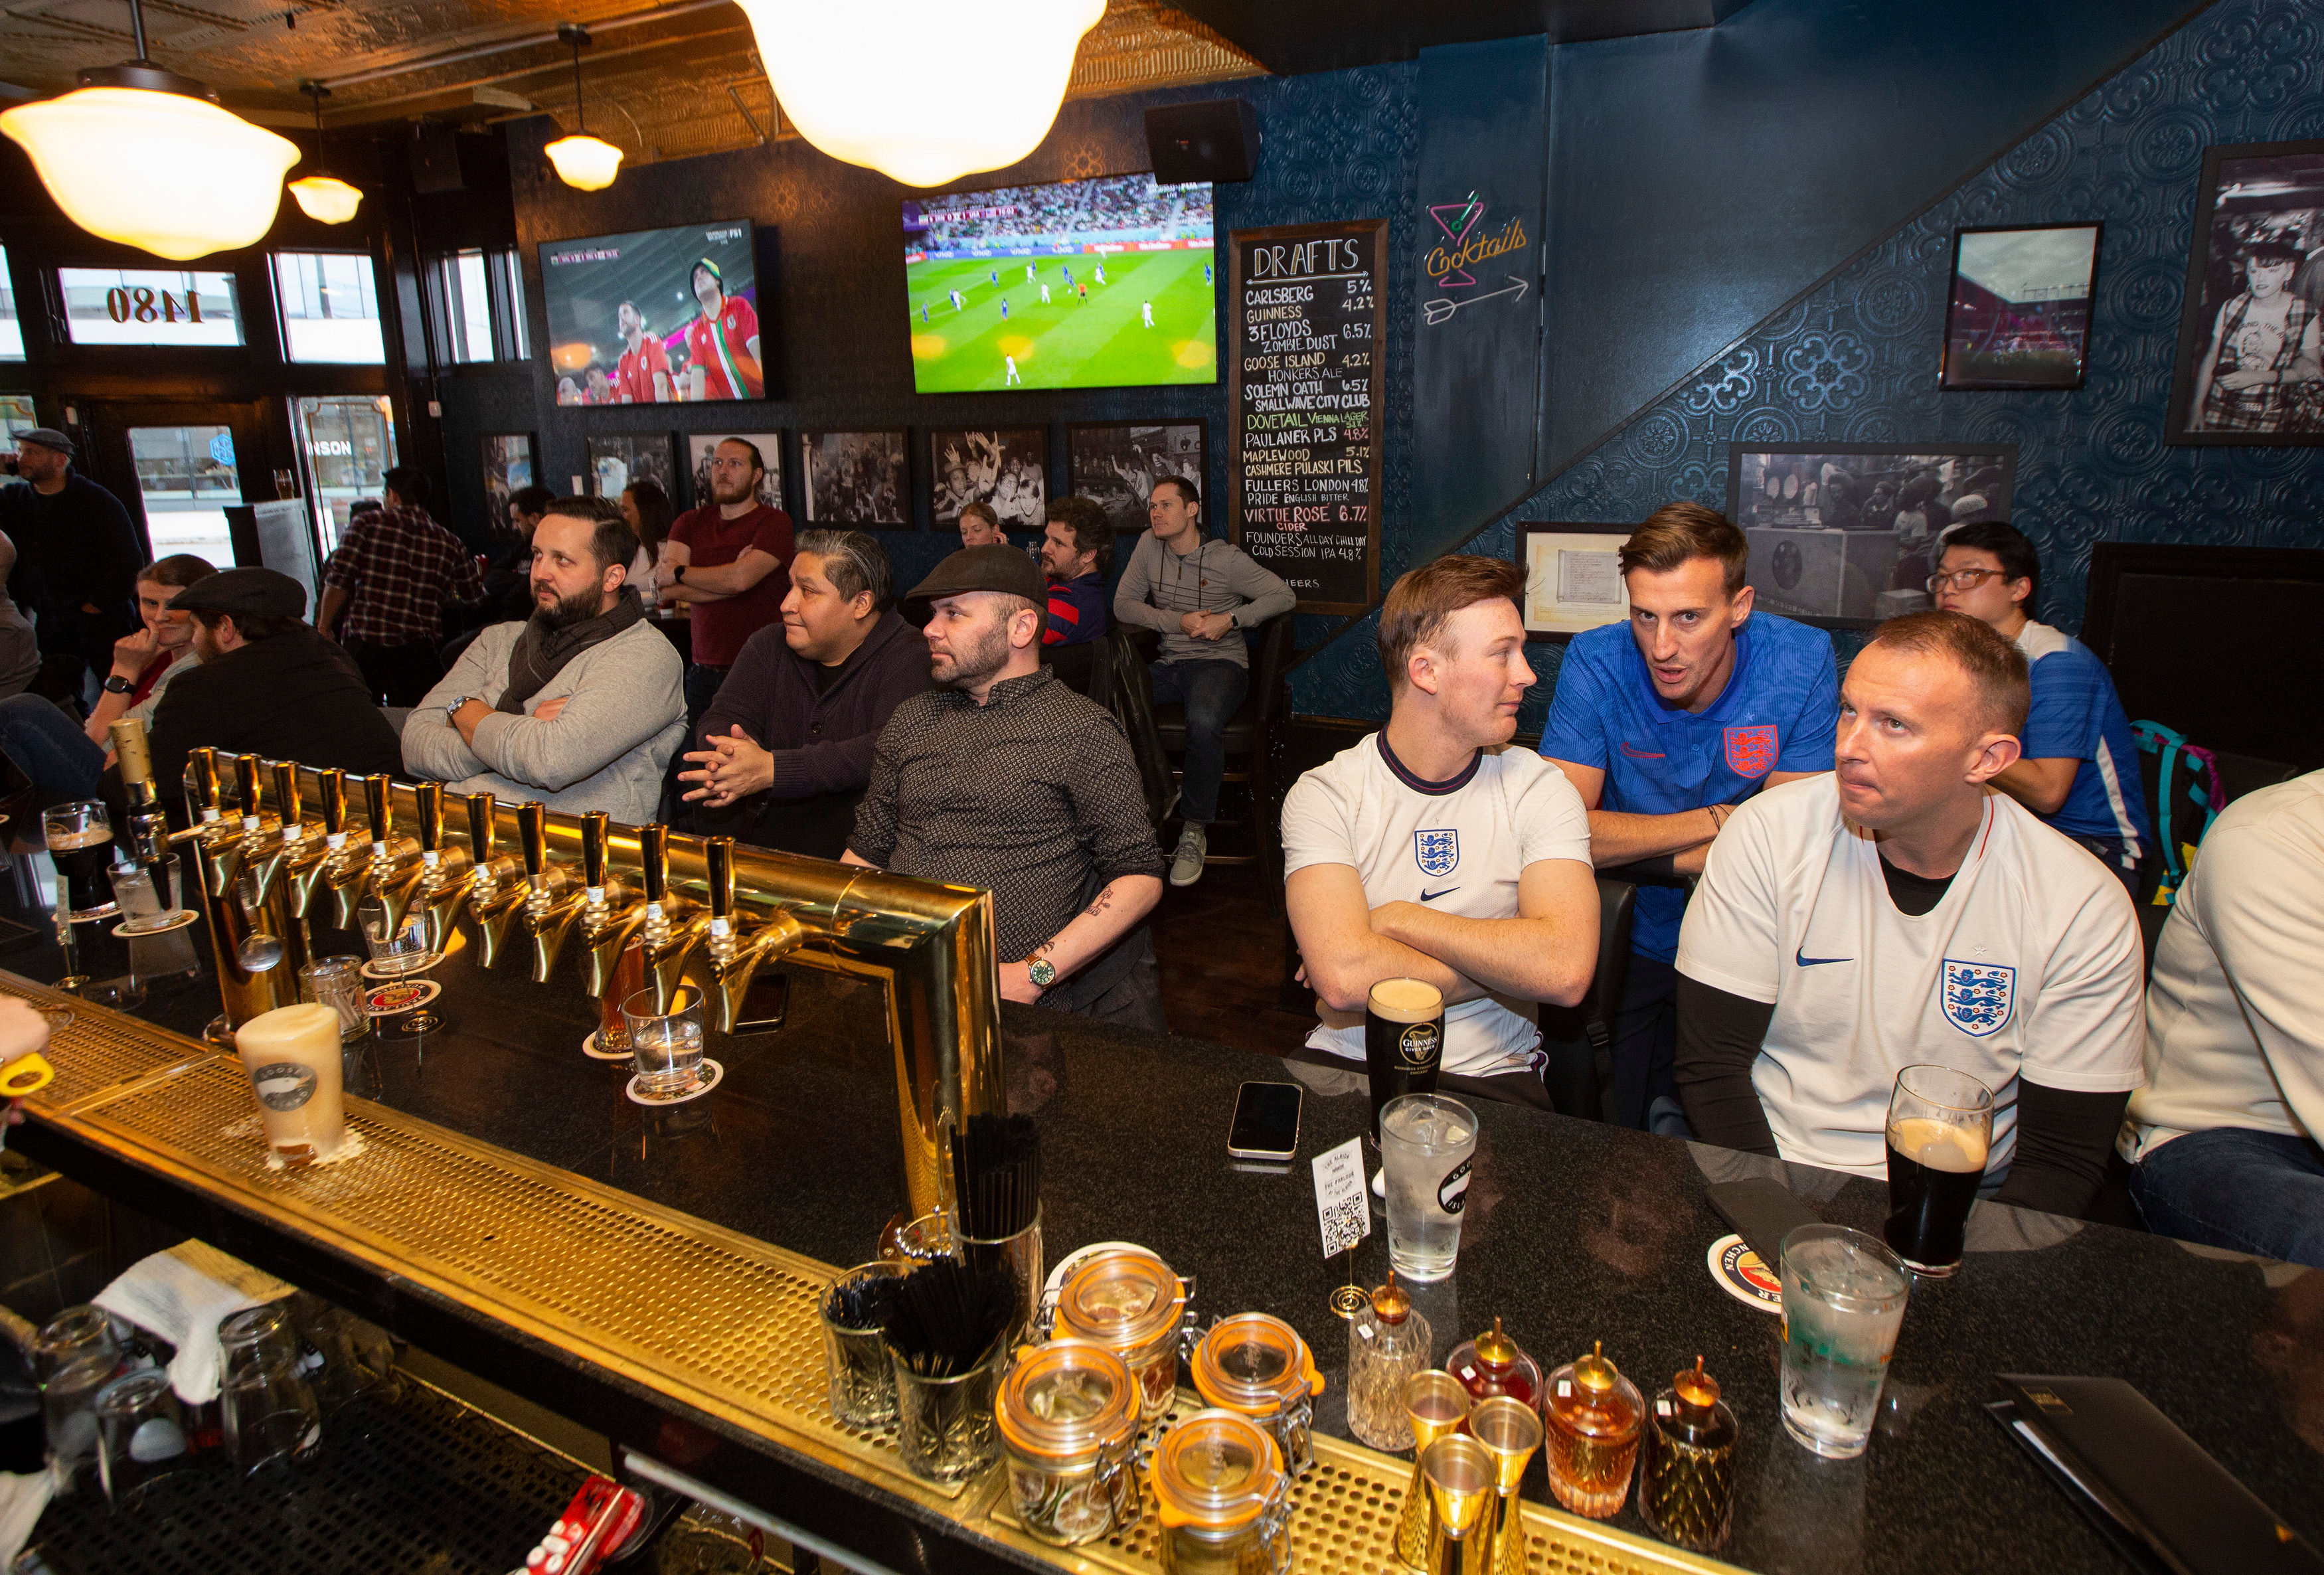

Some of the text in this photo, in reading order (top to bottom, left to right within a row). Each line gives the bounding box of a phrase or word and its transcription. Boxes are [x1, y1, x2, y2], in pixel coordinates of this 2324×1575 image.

[1254, 238, 1359, 276] DRAFTS
[1428, 219, 1527, 277] Cocktails
[1246, 279, 1372, 305] CARLSBERG 5%
[1246, 296, 1374, 323] GUINNESS 4.2%
[1248, 319, 1371, 341] 3 FLOYDS 6.5%
[1262, 334, 1338, 353] ZOMBIE DUST
[1244, 352, 1370, 371] GOOSE ISLAND 4.2%
[1268, 367, 1343, 382] HONKERS ALE
[1244, 378, 1368, 400] SOLEMN OATH 6.5%
[1317, 394, 1340, 408] CITY
[1341, 394, 1370, 408] CLUB
[1247, 413, 1308, 430] DOVETAIL
[1340, 410, 1369, 423] LAGER
[1246, 426, 1369, 448] PAULANER PLS 4.8%
[1243, 446, 1370, 463] MAPLEWOOD 5.1%
[1245, 459, 1363, 477] CASHMERE PULASKI PILS
[1245, 477, 1369, 493] FULLERS LONDON 4.8%
[1248, 493, 1349, 505] PRIDE ENGLISH BITTER
[1244, 502, 1368, 523] VIRTUE ROSÉ 6.7%
[1276, 522, 1308, 531] CIDER
[1246, 531, 1367, 546] FOUNDERS ALL DAY CHILL DAY
[1252, 545, 1361, 560] COLD SESSION IPA 4.8%
[1284, 579, 1320, 588] HEERS
[1403, 1036, 1438, 1047] GUINNESS
[1453, 1160, 1471, 1180] GOO
[1448, 1199, 1465, 1210] ISL
[1724, 1244, 1750, 1272] NCHEN
